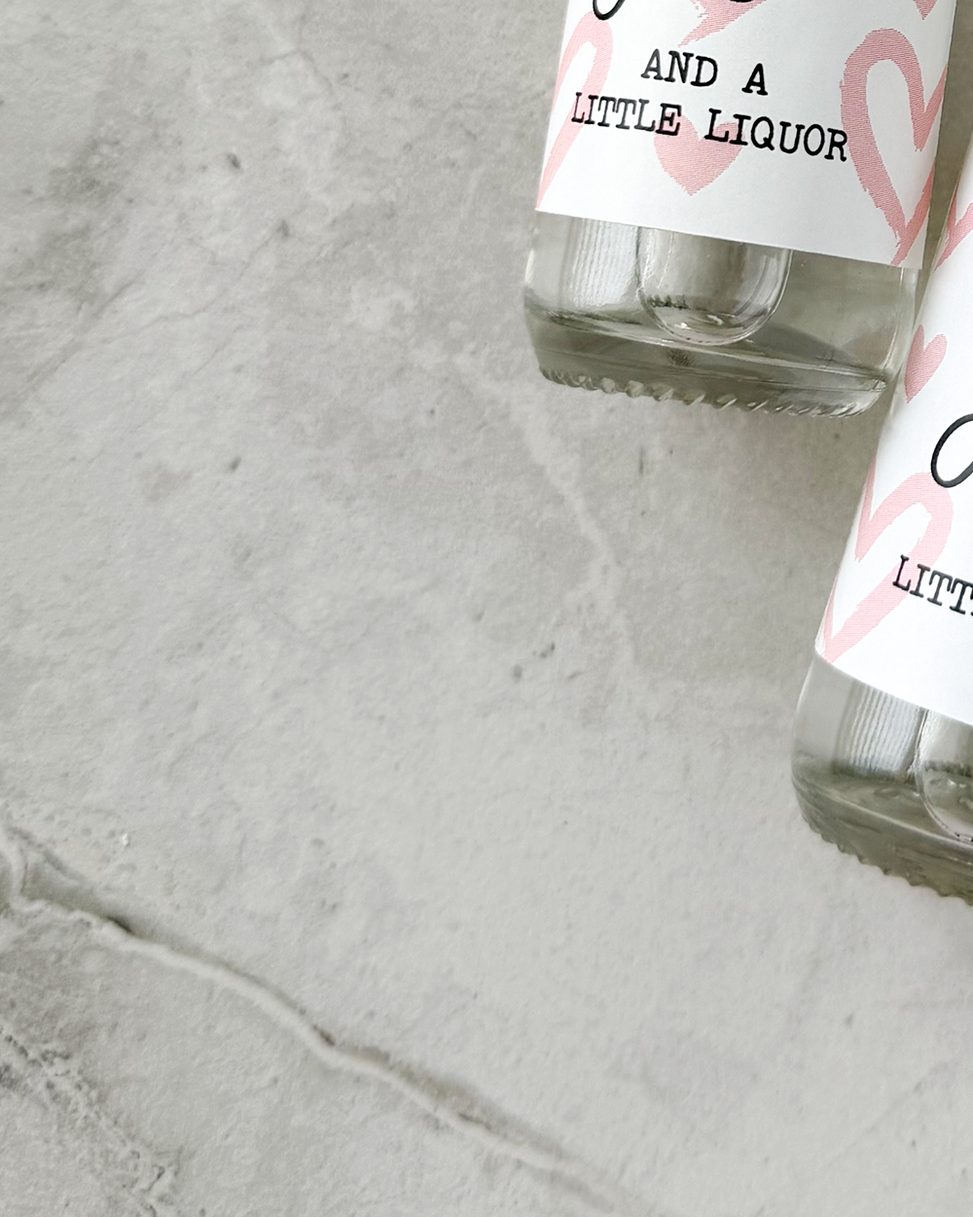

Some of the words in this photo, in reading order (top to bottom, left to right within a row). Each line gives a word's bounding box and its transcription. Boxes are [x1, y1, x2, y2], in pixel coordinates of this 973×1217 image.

[640, 48, 719, 89] AND
[741, 62, 770, 97] A
[570, 91, 683, 138] LITTLE
[703, 107, 849, 164] LIQUOR
